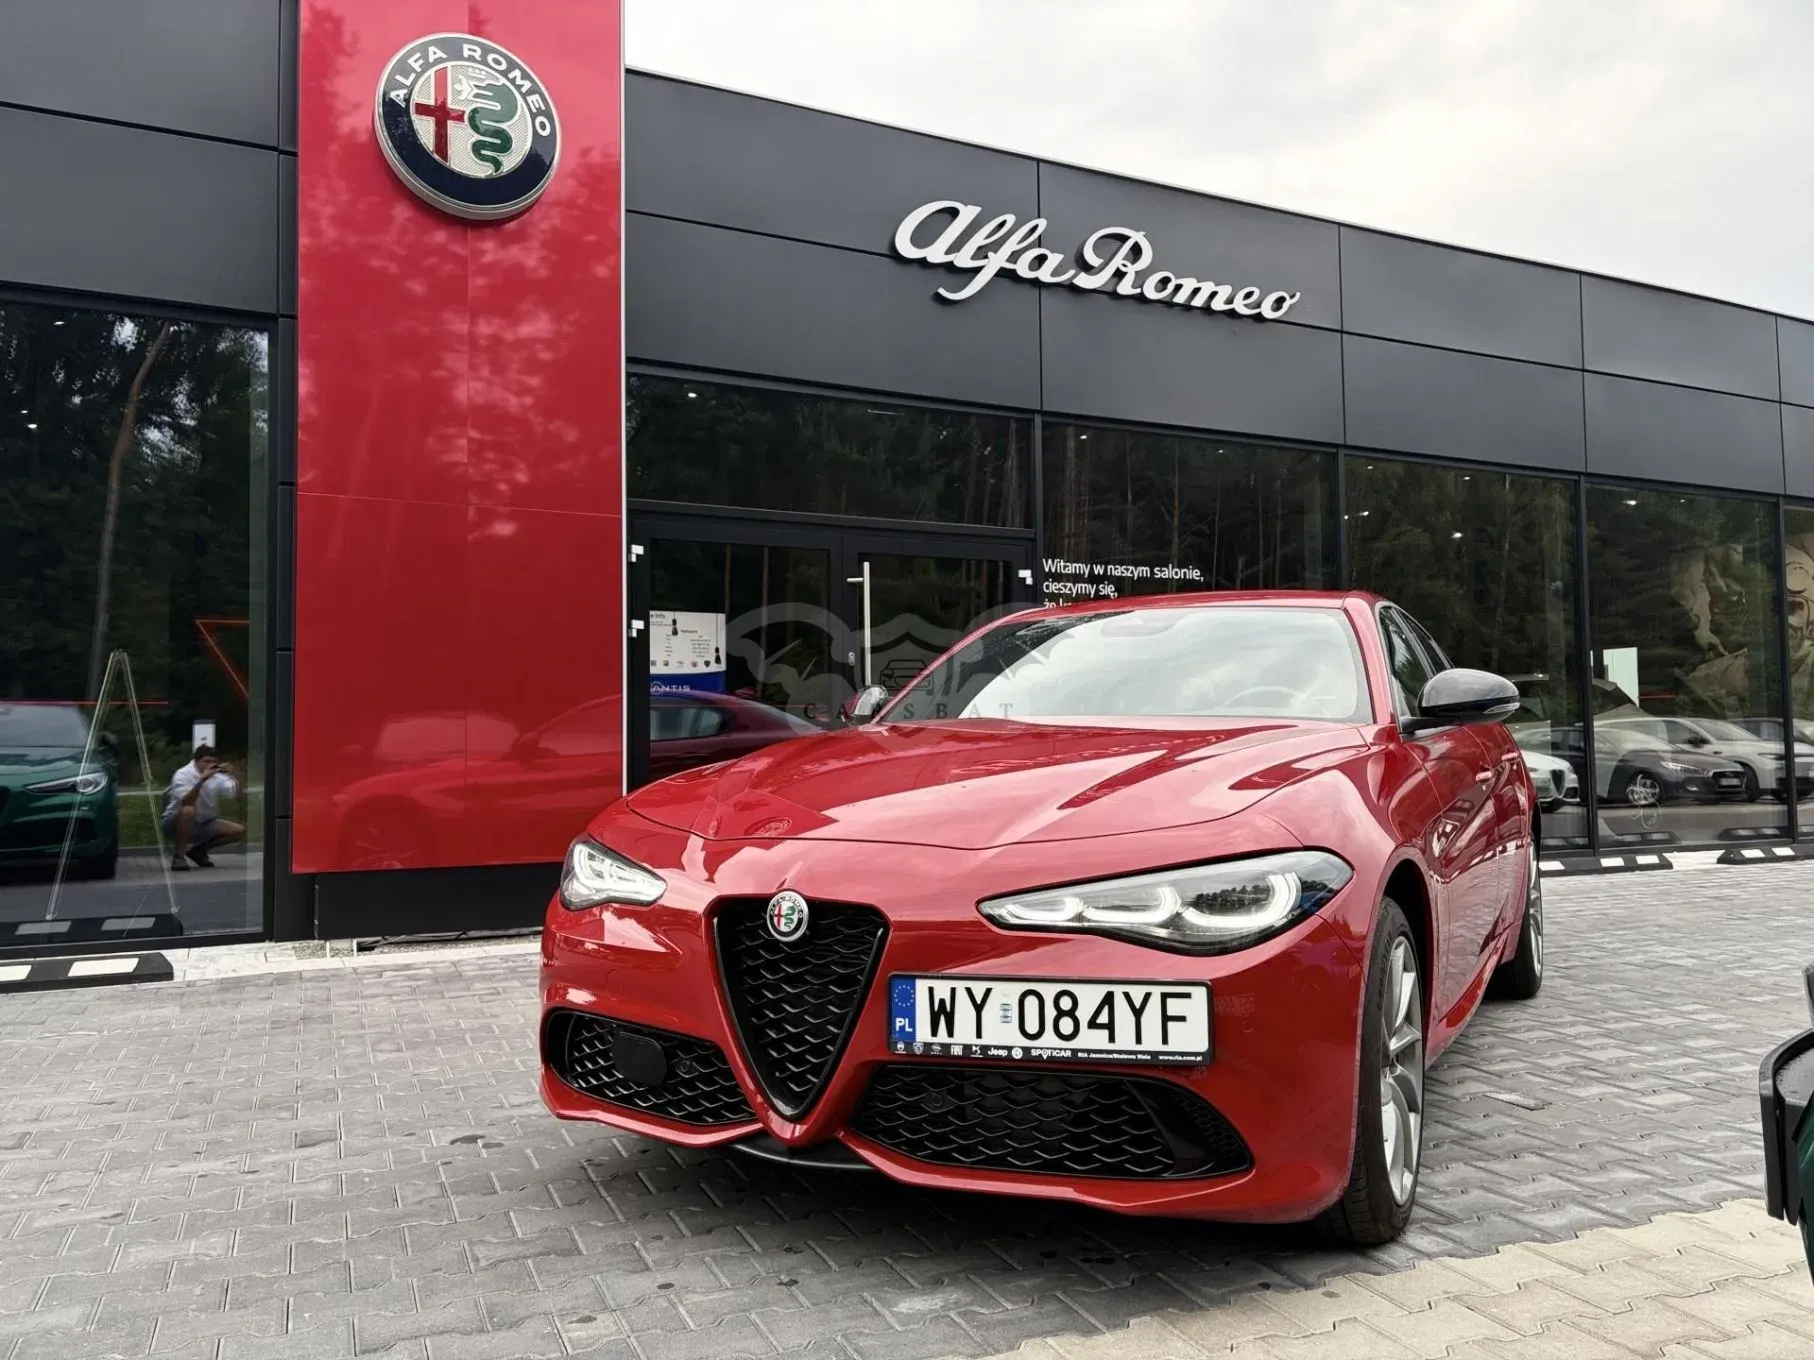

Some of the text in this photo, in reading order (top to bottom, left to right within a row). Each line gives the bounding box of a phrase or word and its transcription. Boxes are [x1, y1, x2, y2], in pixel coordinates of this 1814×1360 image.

[389, 43, 551, 137] ALFA ROMEO
[1074, 226, 1301, 319] Romeo
[1043, 558, 1204, 582] Witamy w naszym salonie,
[1043, 579, 1118, 599] cieszymy się,
[895, 1017, 913, 1033] PL
[927, 986, 1192, 1046] WY 084YF
[988, 1047, 1008, 1057] Jeep
[1031, 1048, 1072, 1060] SPOTICAR
